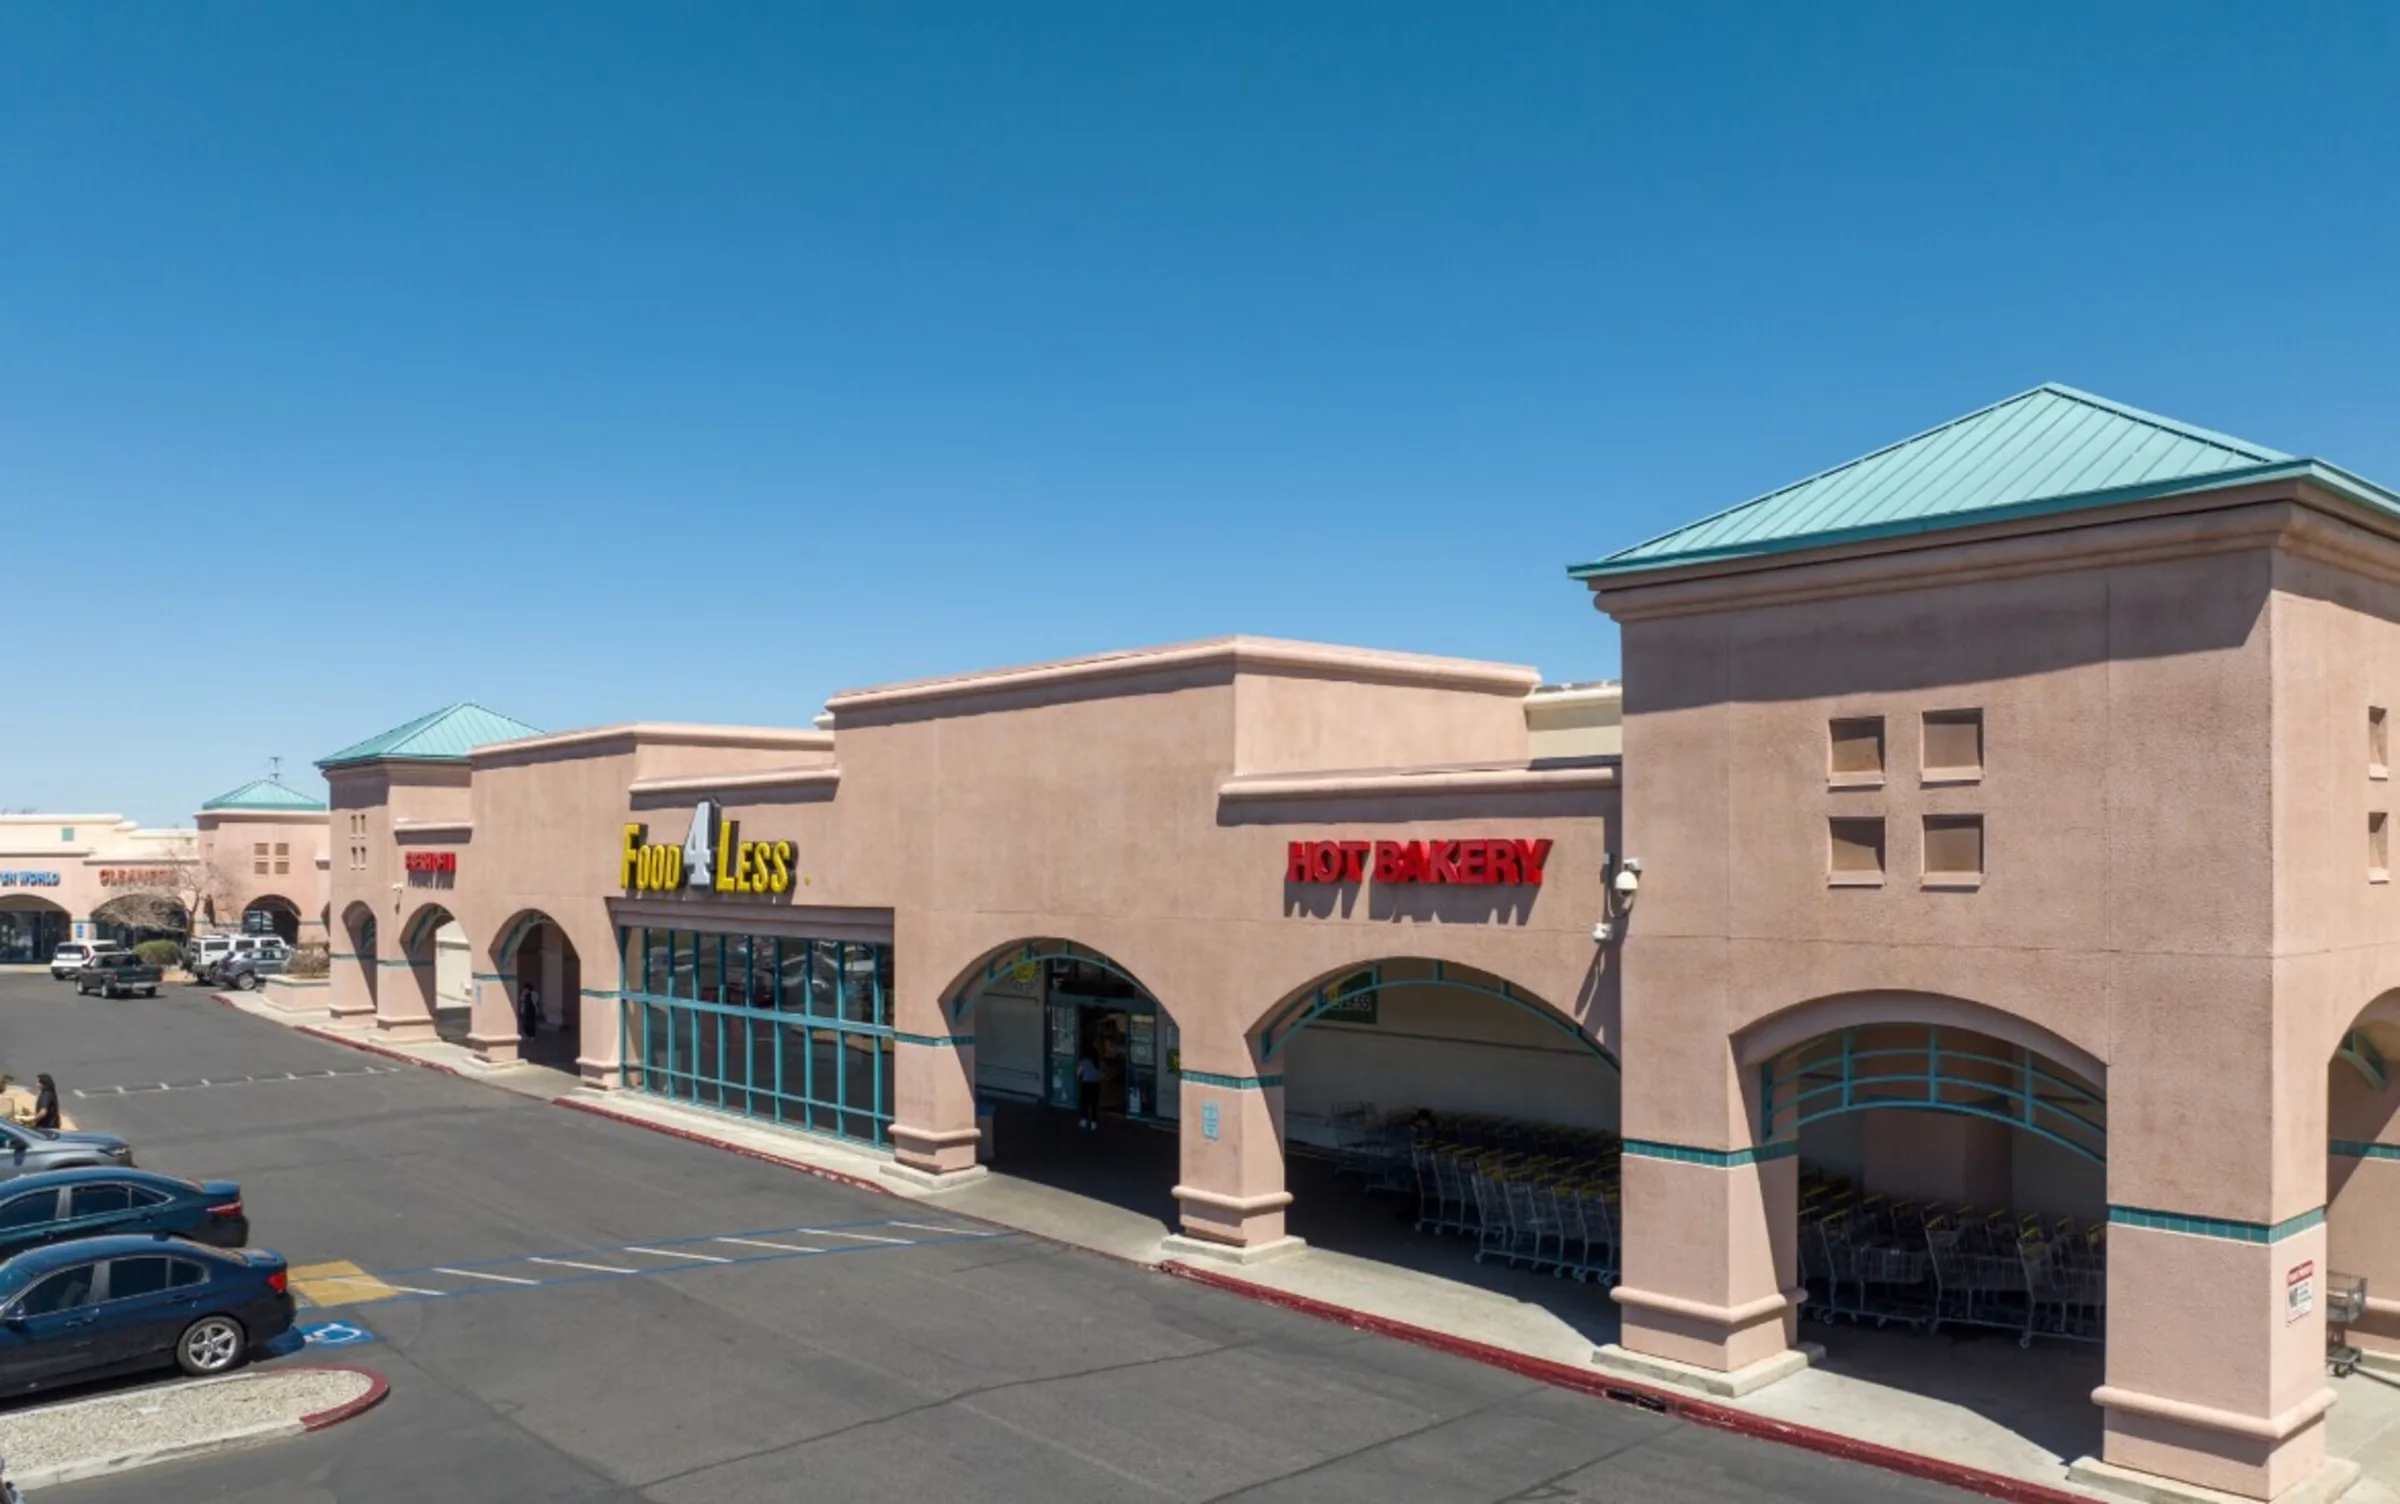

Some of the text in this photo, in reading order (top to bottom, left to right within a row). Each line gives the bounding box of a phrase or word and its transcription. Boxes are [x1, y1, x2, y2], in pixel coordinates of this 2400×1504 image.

[683, 799, 714, 886] 4
[1286, 838, 1554, 885] HOT BAKERY
[20, 871, 61, 887] WORLD
